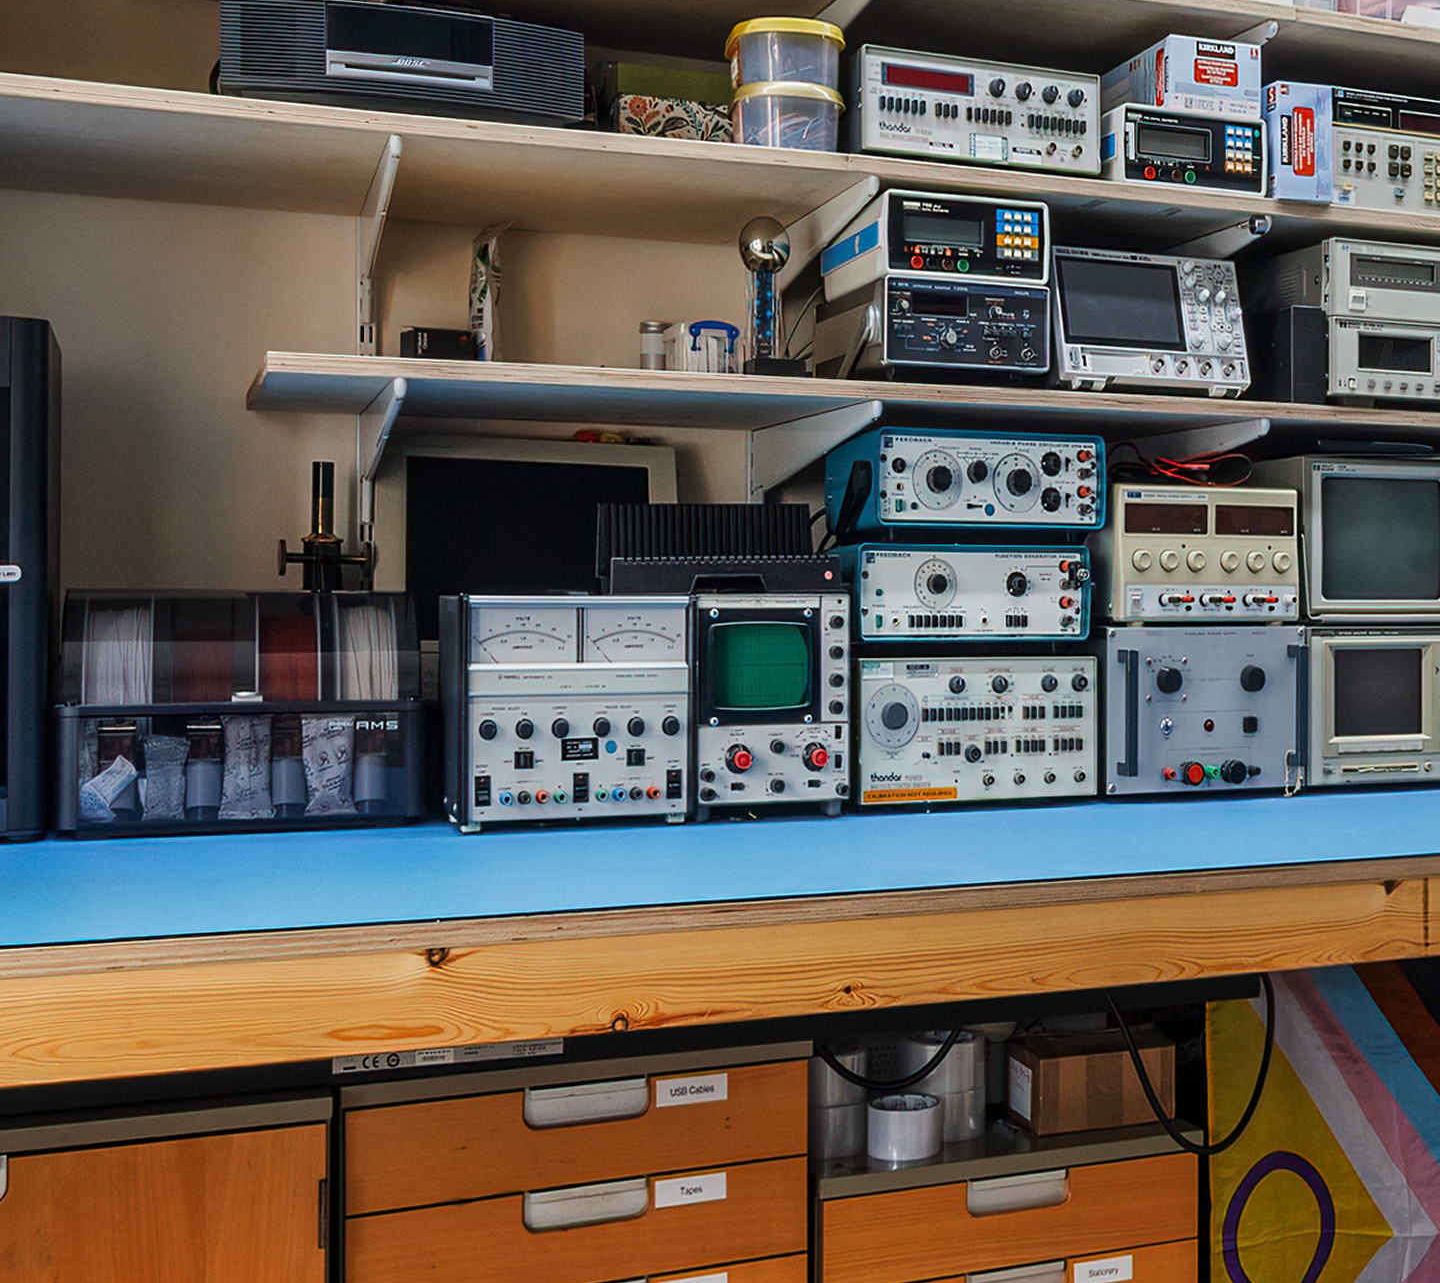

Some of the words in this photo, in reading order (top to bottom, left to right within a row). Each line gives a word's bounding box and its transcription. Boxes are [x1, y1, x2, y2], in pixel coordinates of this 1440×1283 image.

[1198, 42, 1235, 55] KIRKLAND
[879, 121, 911, 134] thandar
[1281, 117, 1290, 163] KIRKLAND
[356, 720, 398, 730] AMS
[871, 772, 902, 782] thandar
[670, 1086, 687, 1097] USB
[689, 1085, 715, 1095] Cables
[680, 1185, 703, 1196] Tapes
